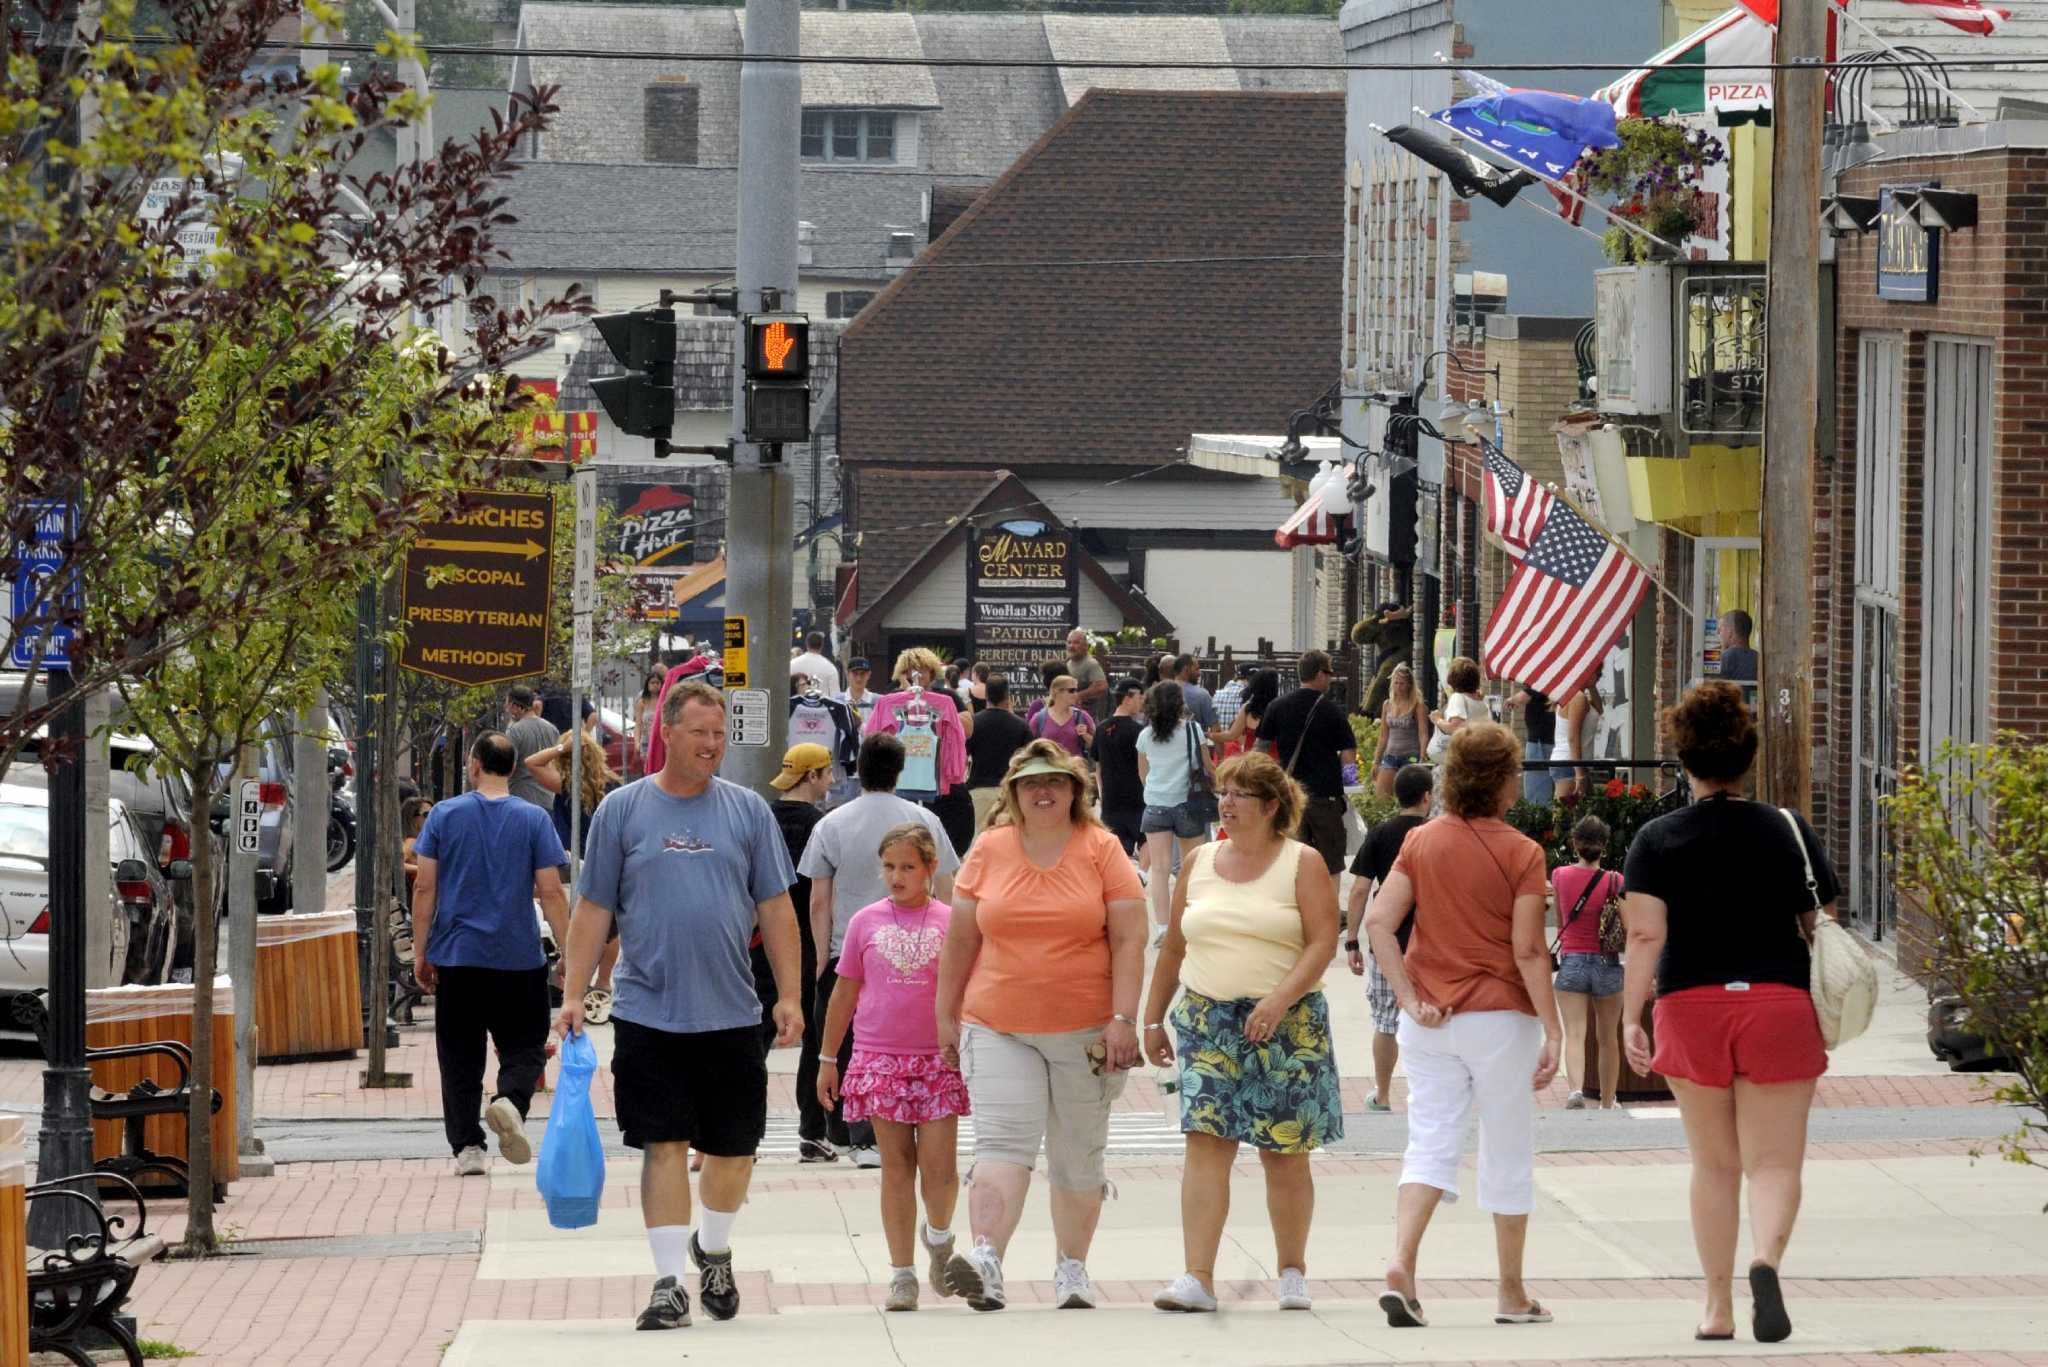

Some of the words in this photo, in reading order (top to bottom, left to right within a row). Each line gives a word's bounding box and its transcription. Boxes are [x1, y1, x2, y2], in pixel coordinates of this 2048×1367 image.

[1708, 84, 1768, 101] PIZZA
[178, 231, 215, 244] RESTAUR
[1731, 373, 1764, 389] STY
[421, 507, 546, 529] URCHES
[620, 508, 693, 552] Pizza
[633, 528, 687, 560] Hut
[979, 535, 1067, 562] MAYARD
[429, 565, 526, 586] ISCOPAL
[983, 563, 1064, 577] CENTER
[407, 606, 544, 627] PRESBYTERIAN
[1029, 604, 1065, 617] SHOP
[991, 626, 1061, 639] PATRIOT
[24, 635, 66, 656] PEMIT
[979, 648, 1028, 661] PERFECT
[421, 647, 527, 667] METHODIST
[1780, 688, 1791, 706] 3
